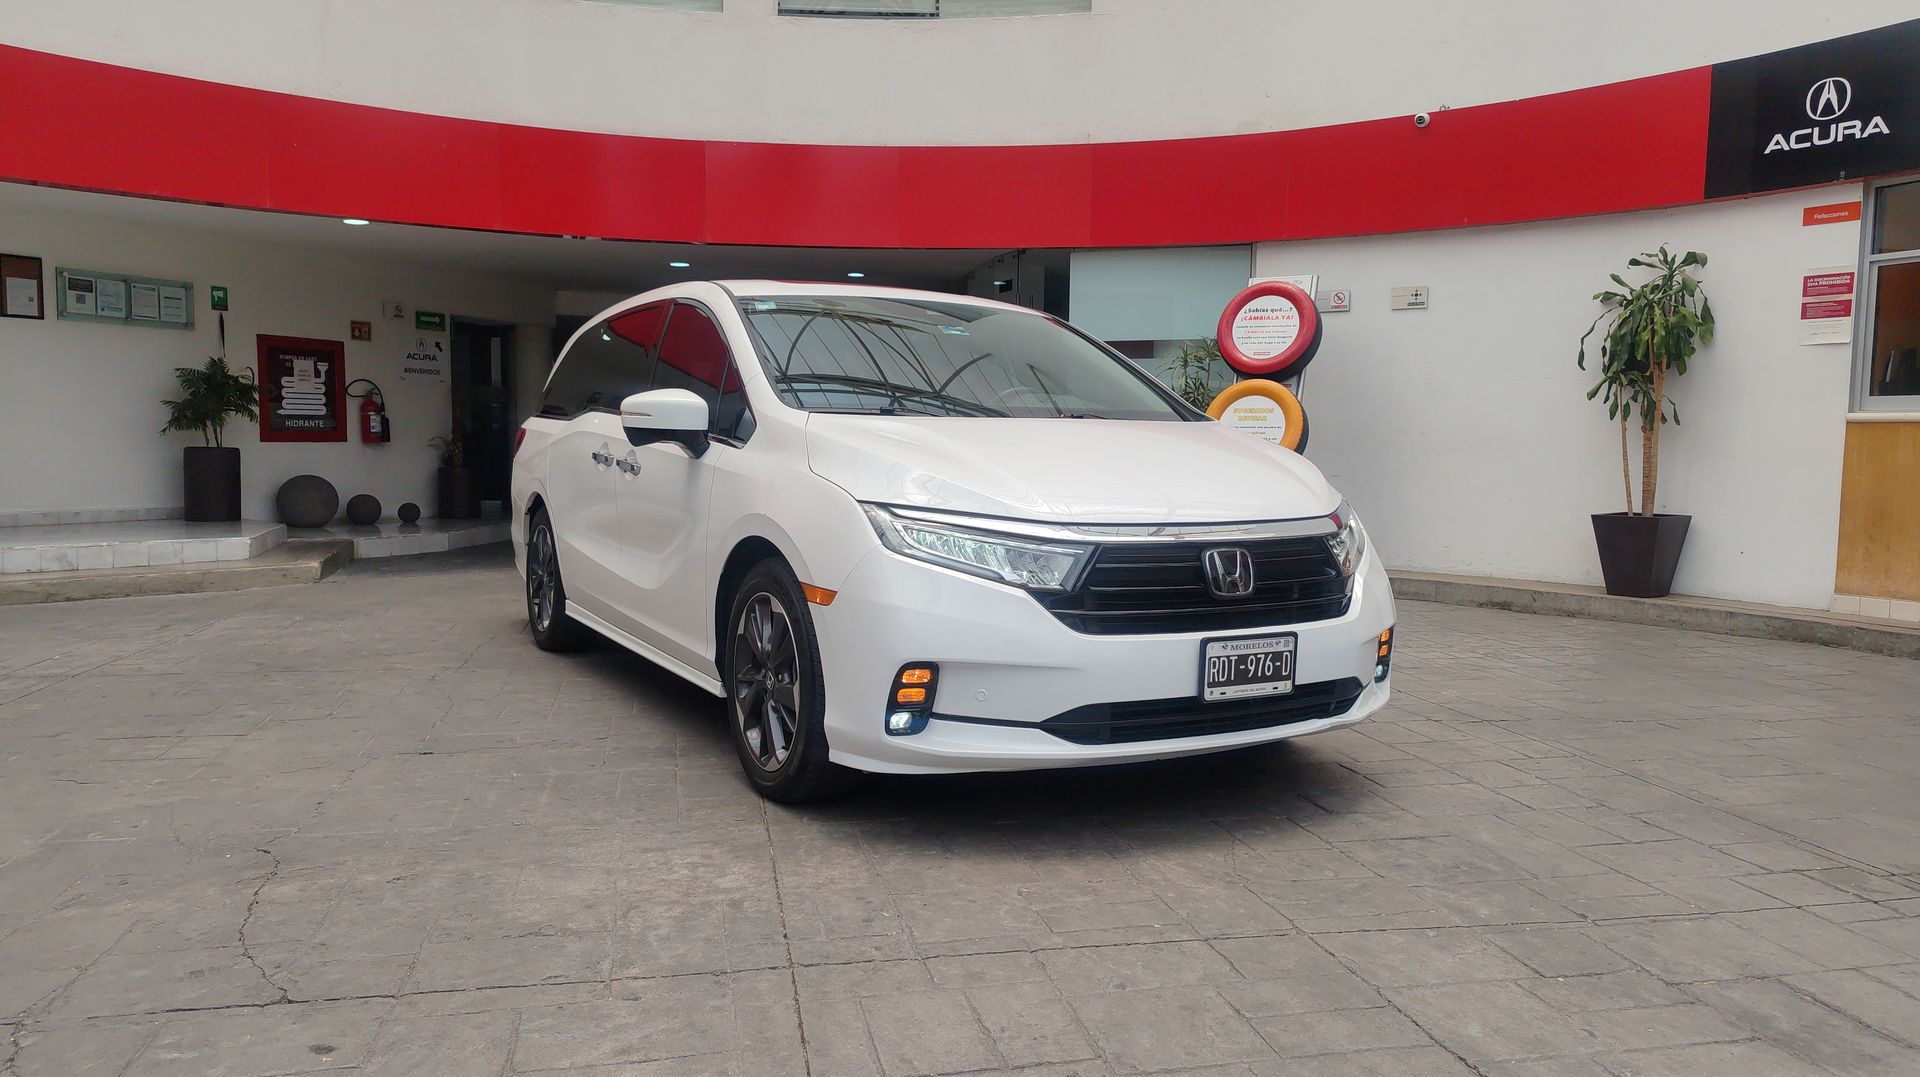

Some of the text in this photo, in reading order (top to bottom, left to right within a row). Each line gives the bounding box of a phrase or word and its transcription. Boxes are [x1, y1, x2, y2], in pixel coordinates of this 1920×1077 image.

[1763, 115, 1891, 155] ACURA
[1814, 210, 1849, 220] Refacciones
[406, 352, 438, 362] ACURA
[404, 367, 440, 376] BIENVENIDOS
[285, 420, 325, 428] HIDRANTE
[1230, 641, 1274, 651] MORELOS
[1209, 652, 1291, 682] RDT-976-D
